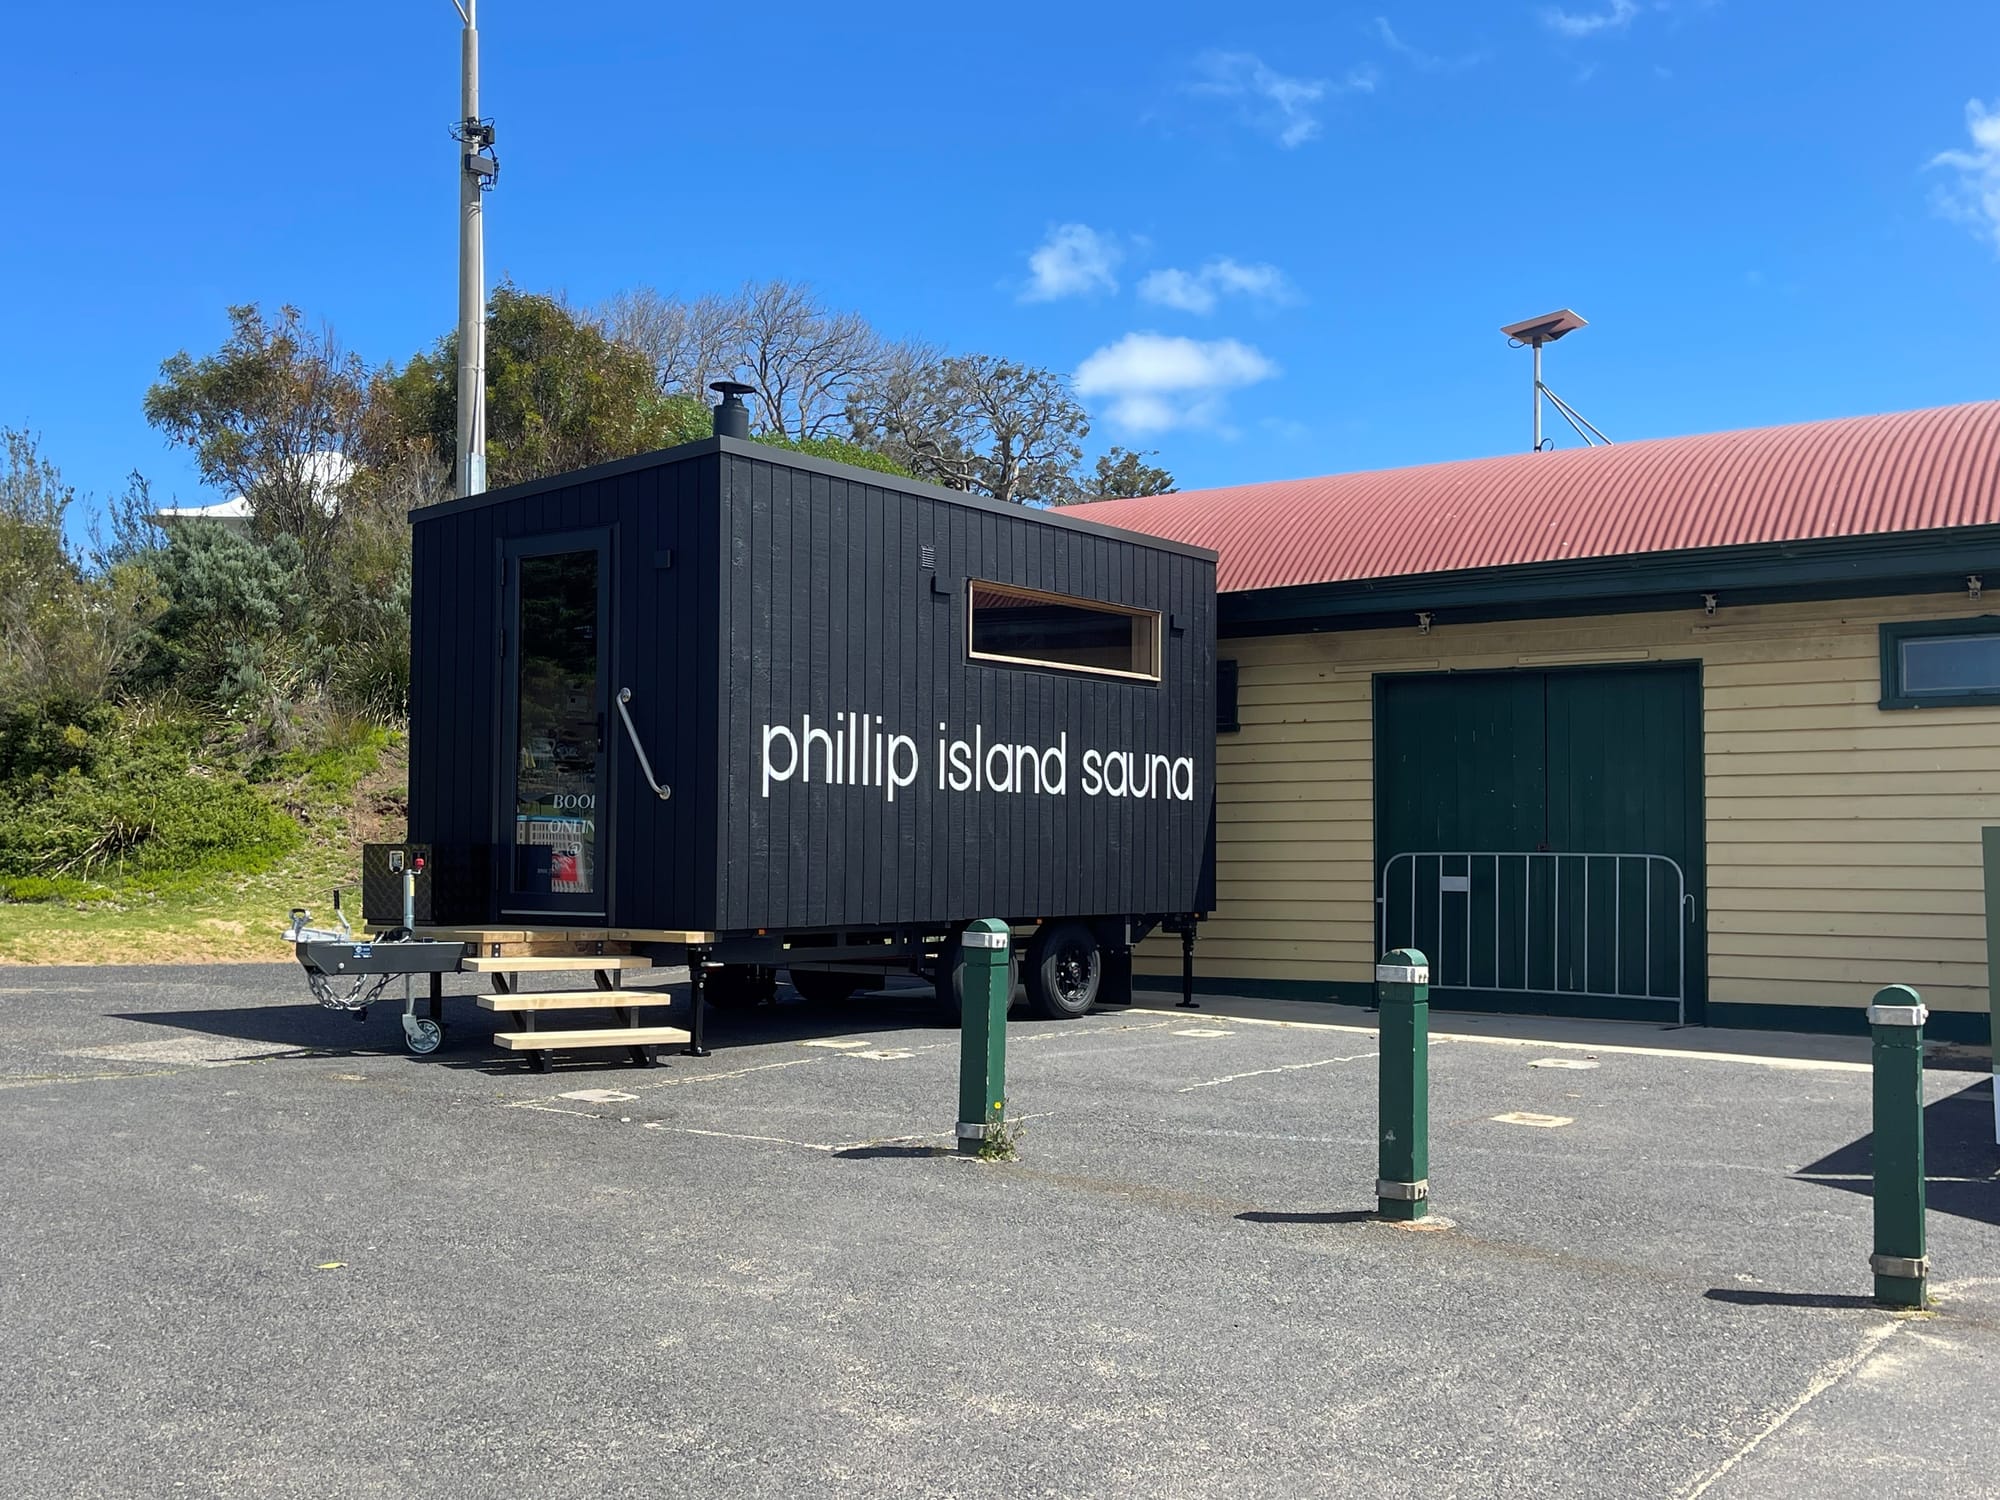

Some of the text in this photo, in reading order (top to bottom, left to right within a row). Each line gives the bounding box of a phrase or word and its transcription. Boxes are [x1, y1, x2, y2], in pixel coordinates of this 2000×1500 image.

[761, 711, 1193, 802] phillip island sauna
[549, 819, 595, 834] ONLIN
